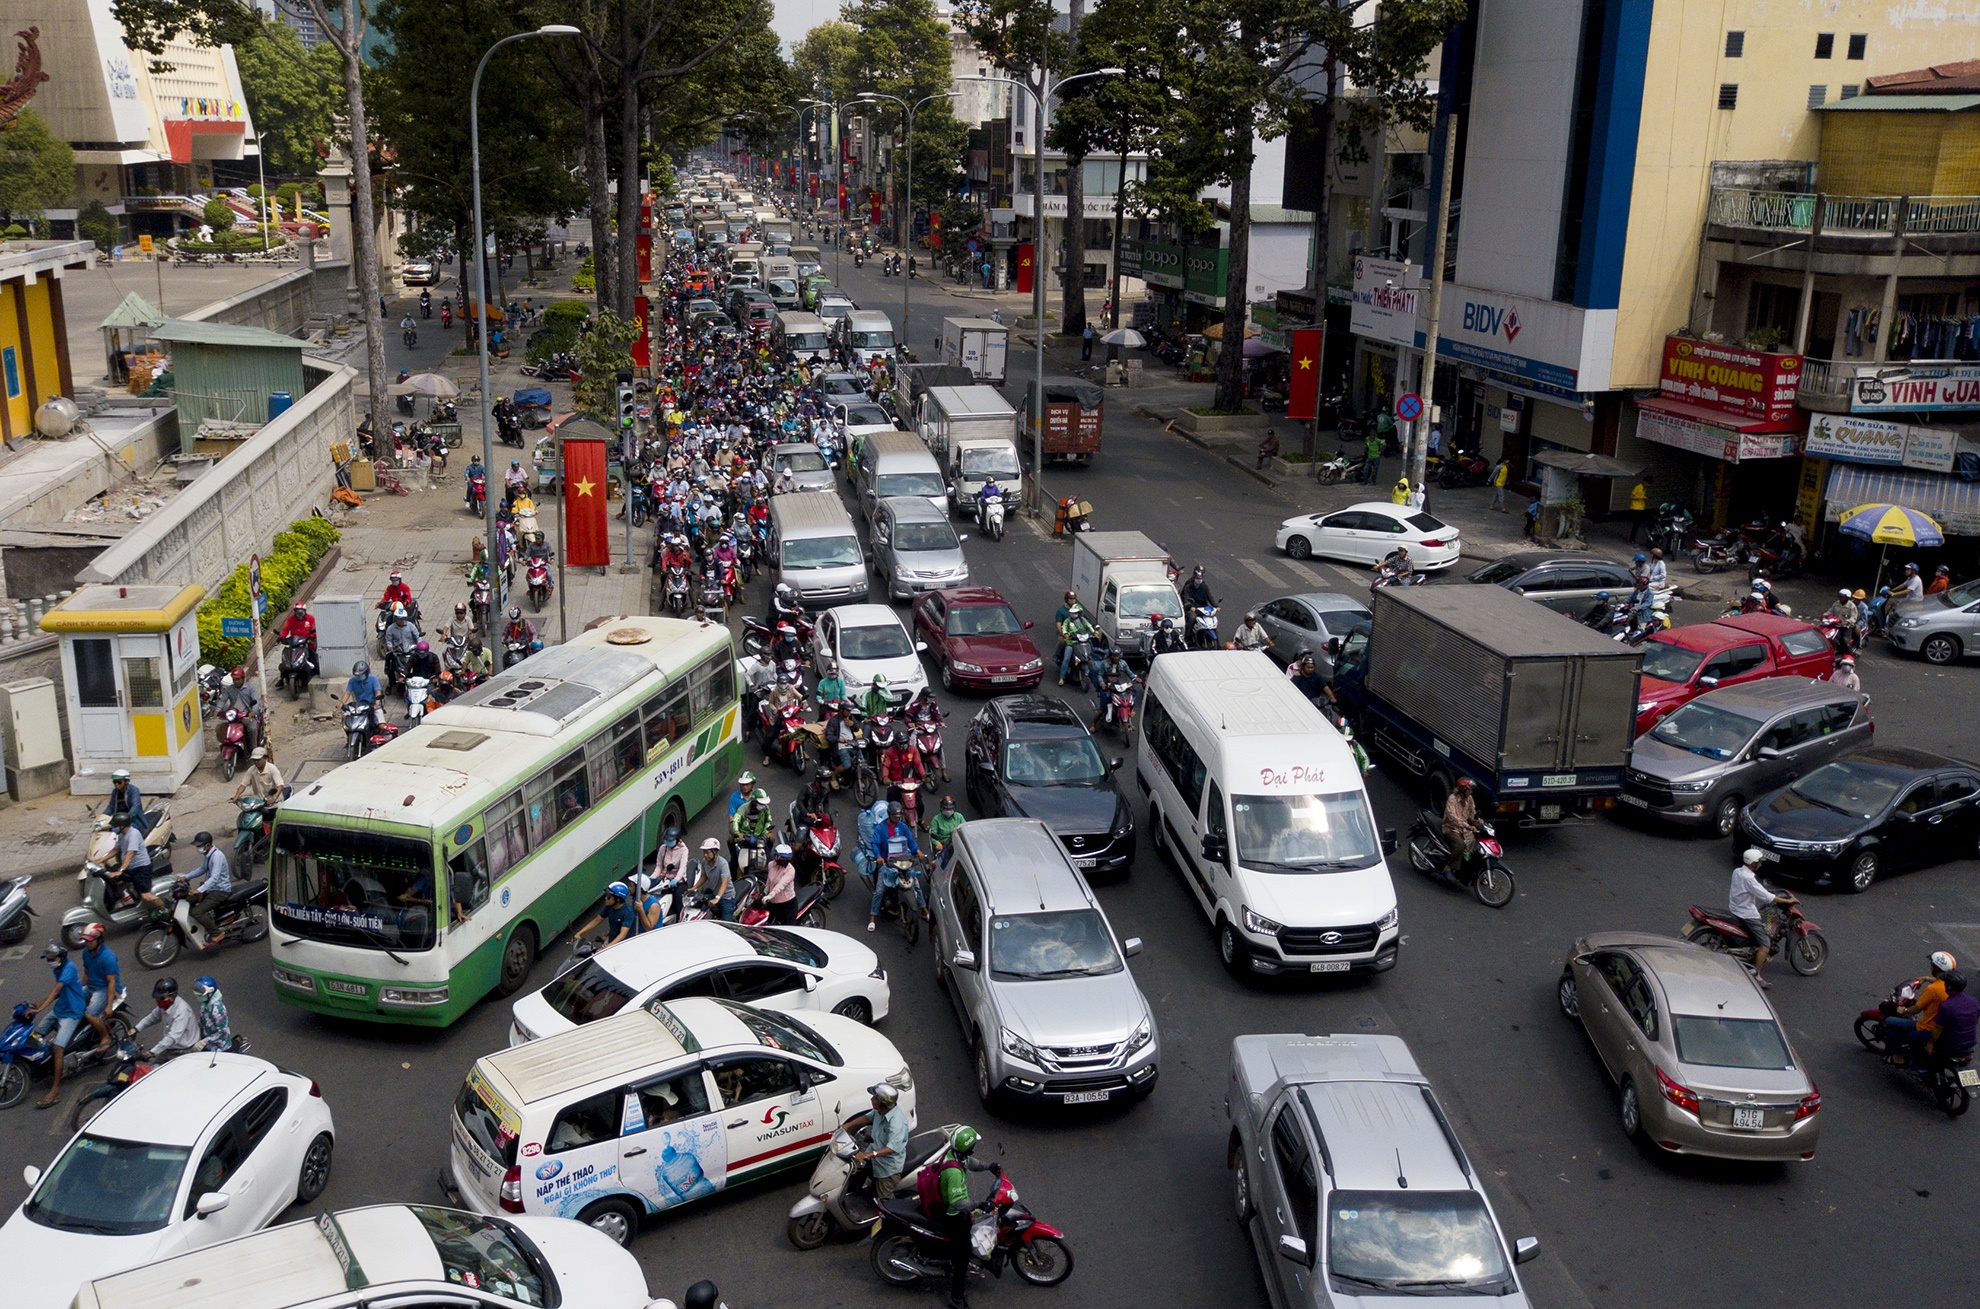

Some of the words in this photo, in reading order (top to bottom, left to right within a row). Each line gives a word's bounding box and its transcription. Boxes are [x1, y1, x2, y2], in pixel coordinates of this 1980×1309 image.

[1463, 302, 1504, 336] BIDV
[1670, 358, 1705, 381] VINH
[1707, 365, 1763, 392] QUANG
[1892, 382, 1938, 403] VINH
[1844, 420, 1865, 428] TIỆM
[1867, 421, 1884, 430] SỬA
[1835, 426, 1902, 449] QUANG
[1260, 768, 1288, 788] Đại
[1292, 766, 1325, 784] Phát
[1069, 1046, 1098, 1054] ISUZU
[1741, 1109, 1757, 1119] 51G
[522, 1143, 541, 1156] 8296
[572, 1164, 594, 1181] THAO
[574, 1176, 598, 1191] KHÔNG
